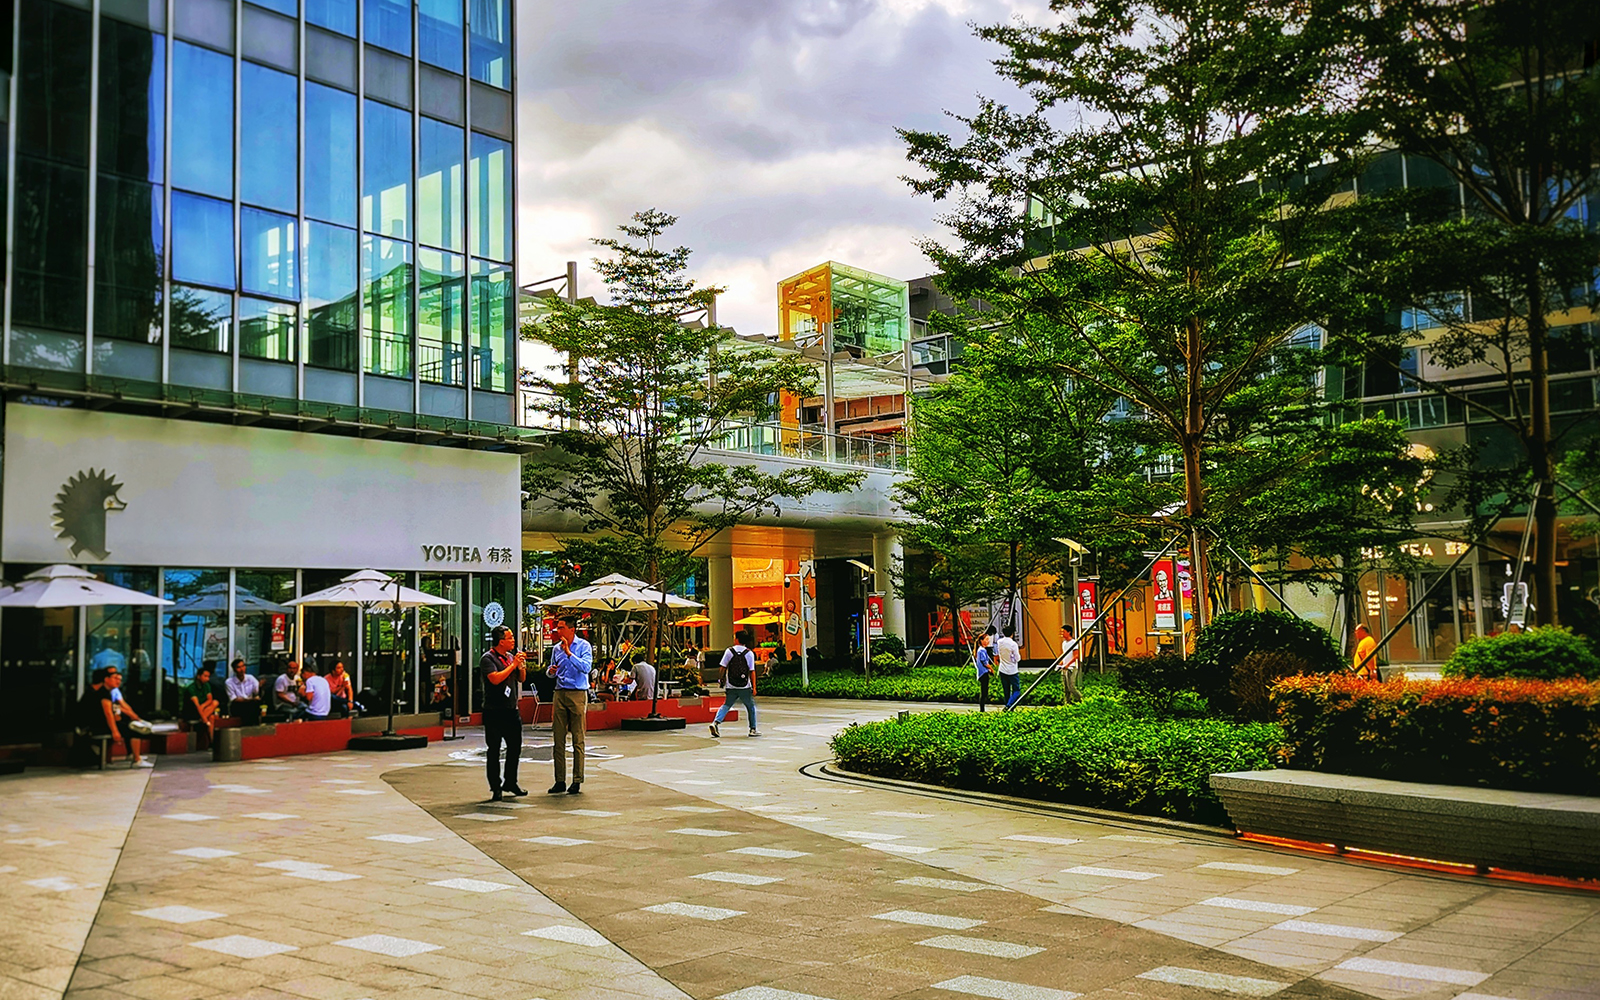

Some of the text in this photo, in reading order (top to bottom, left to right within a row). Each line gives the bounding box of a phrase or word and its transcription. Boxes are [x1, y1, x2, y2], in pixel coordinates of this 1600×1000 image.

[421, 545, 512, 563] YO!TEA 有茶
[1361, 543, 1434, 559] HETEA
